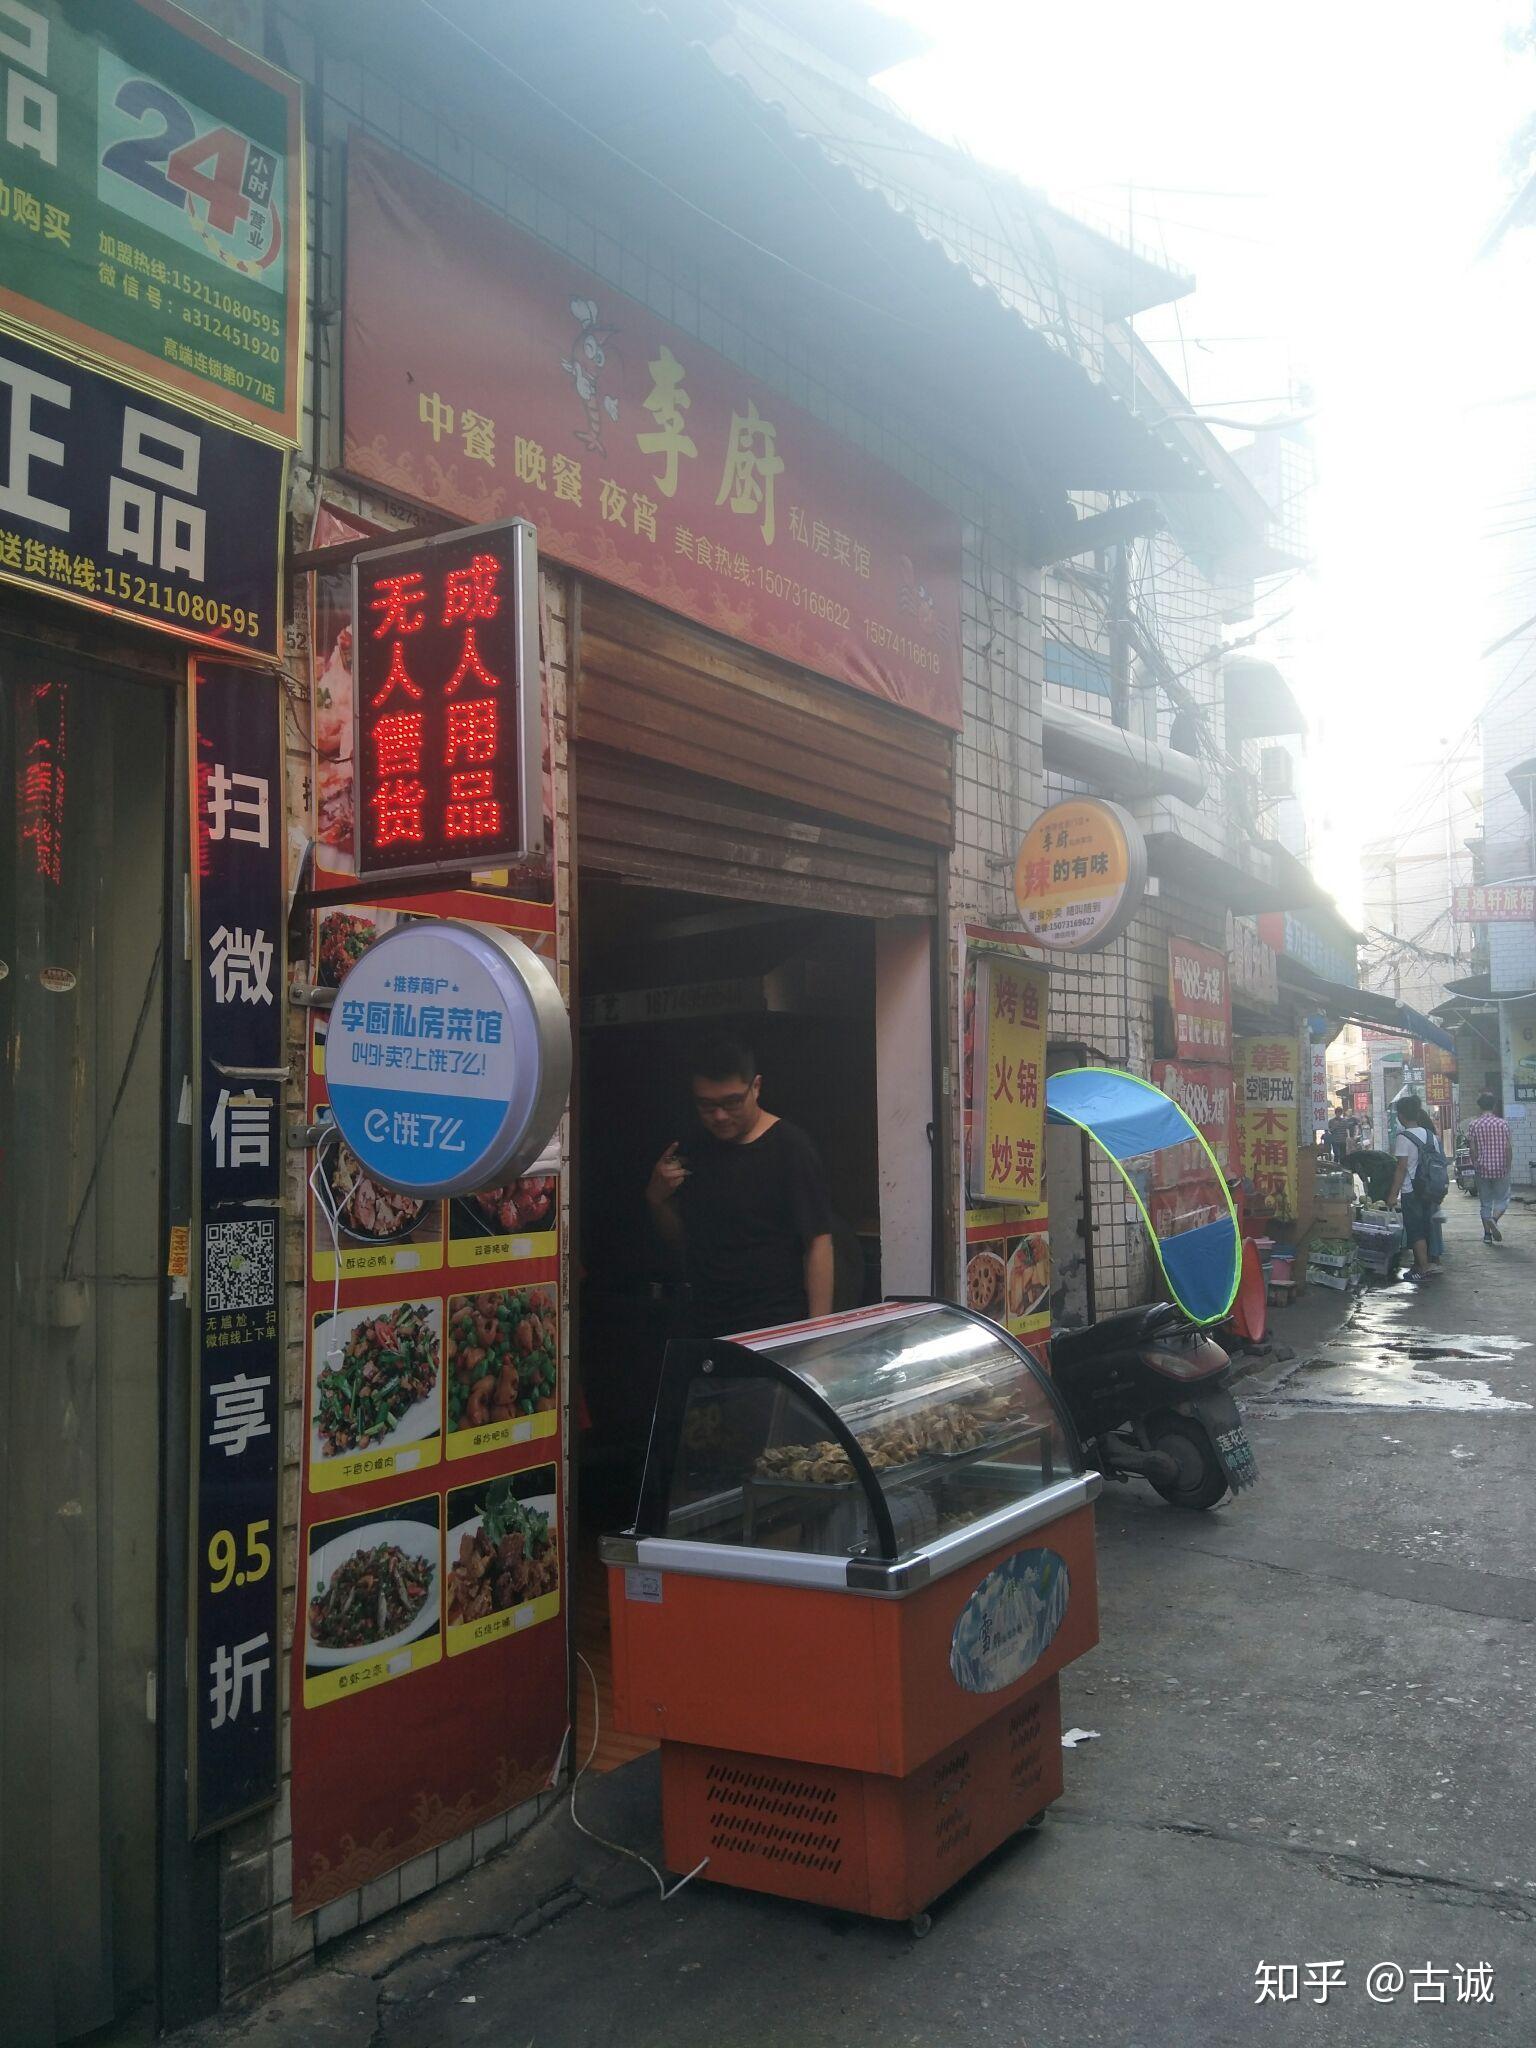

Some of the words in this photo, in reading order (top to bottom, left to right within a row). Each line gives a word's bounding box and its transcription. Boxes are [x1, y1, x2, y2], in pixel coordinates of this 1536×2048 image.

[101, 79, 251, 236] 24
[99, 230, 280, 338] 加盟热线:15211080595
[162, 335, 276, 405] 高端连锁第077店
[419, 391, 496, 468] 中餐
[514, 434, 583, 508] 晚餐
[599, 478, 658, 543] 夜宵
[635, 345, 785, 546] 李厨
[788, 505, 872, 579] 私房菜馆
[371, 571, 426, 848] 无人售货
[443, 553, 500, 839] 成人用品
[393, 976, 449, 995] 推荐商户
[994, 970, 1041, 1031] 烤鱼
[341, 1000, 502, 1044] 李厨私房菜馆
[993, 1055, 1038, 1109] 火锅
[1246, 1076, 1294, 1102] 空调开放
[1431, 1073, 1446, 1101] 出租
[392, 1112, 466, 1152] 饿了么
[990, 1134, 1037, 1188] 炒菜
[205, 1326, 276, 1349] 微信线上下单
